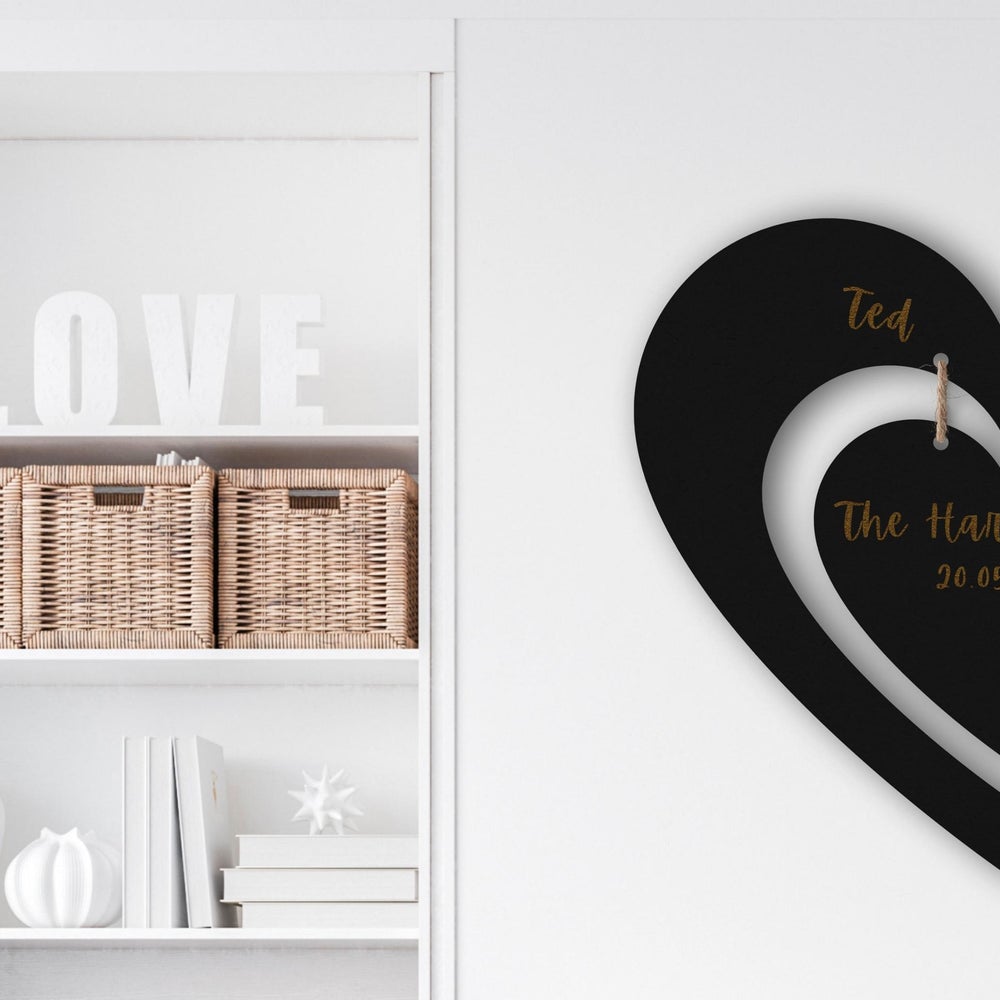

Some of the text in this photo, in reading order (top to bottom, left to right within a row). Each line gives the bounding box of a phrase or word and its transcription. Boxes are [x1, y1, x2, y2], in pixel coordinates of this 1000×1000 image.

[843, 286, 915, 342] Ted
[0, 291, 324, 426] OVE
[834, 500, 908, 541] The
